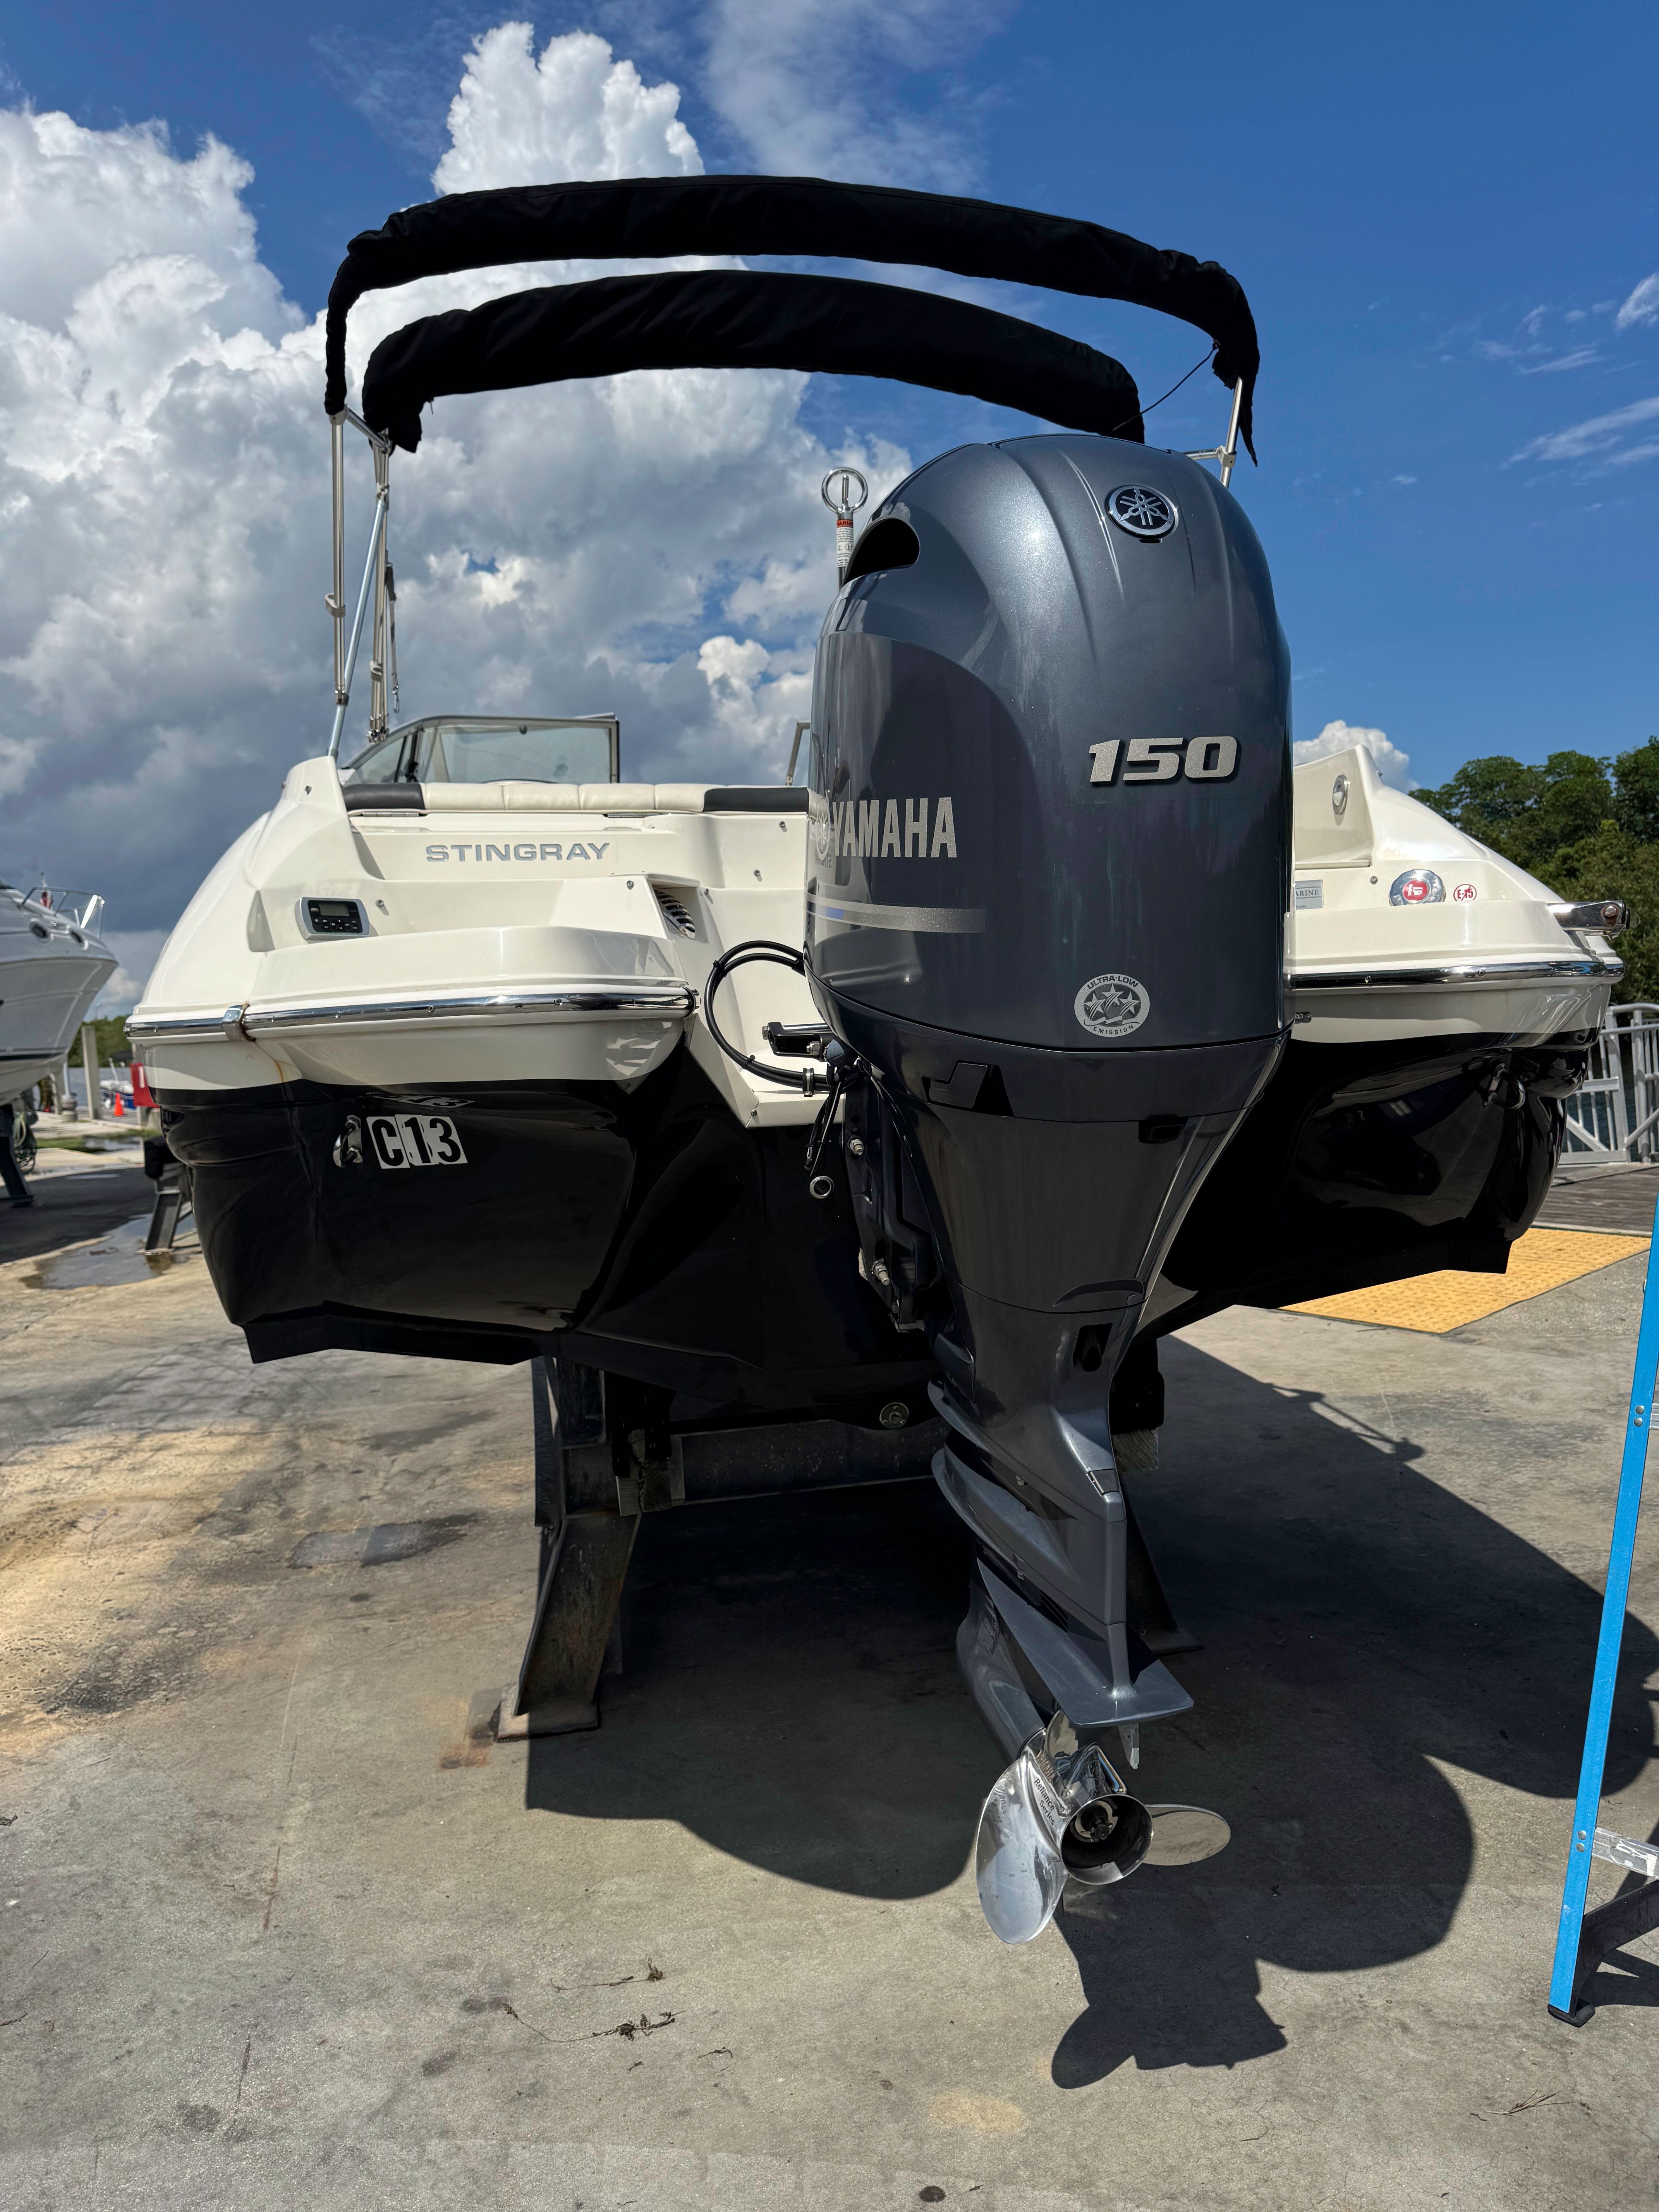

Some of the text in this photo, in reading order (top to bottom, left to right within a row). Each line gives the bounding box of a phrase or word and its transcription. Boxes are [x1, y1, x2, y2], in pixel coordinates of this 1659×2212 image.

[1089, 736, 1237, 782] 150
[832, 797, 957, 858] YAMAHA
[426, 843, 610, 862] STINGRAY
[1093, 1024, 1134, 1035] EMISSION
[371, 1117, 461, 1166] C13
[1034, 1778, 1055, 1811] Reliance
[1039, 1800, 1055, 1826] Series
